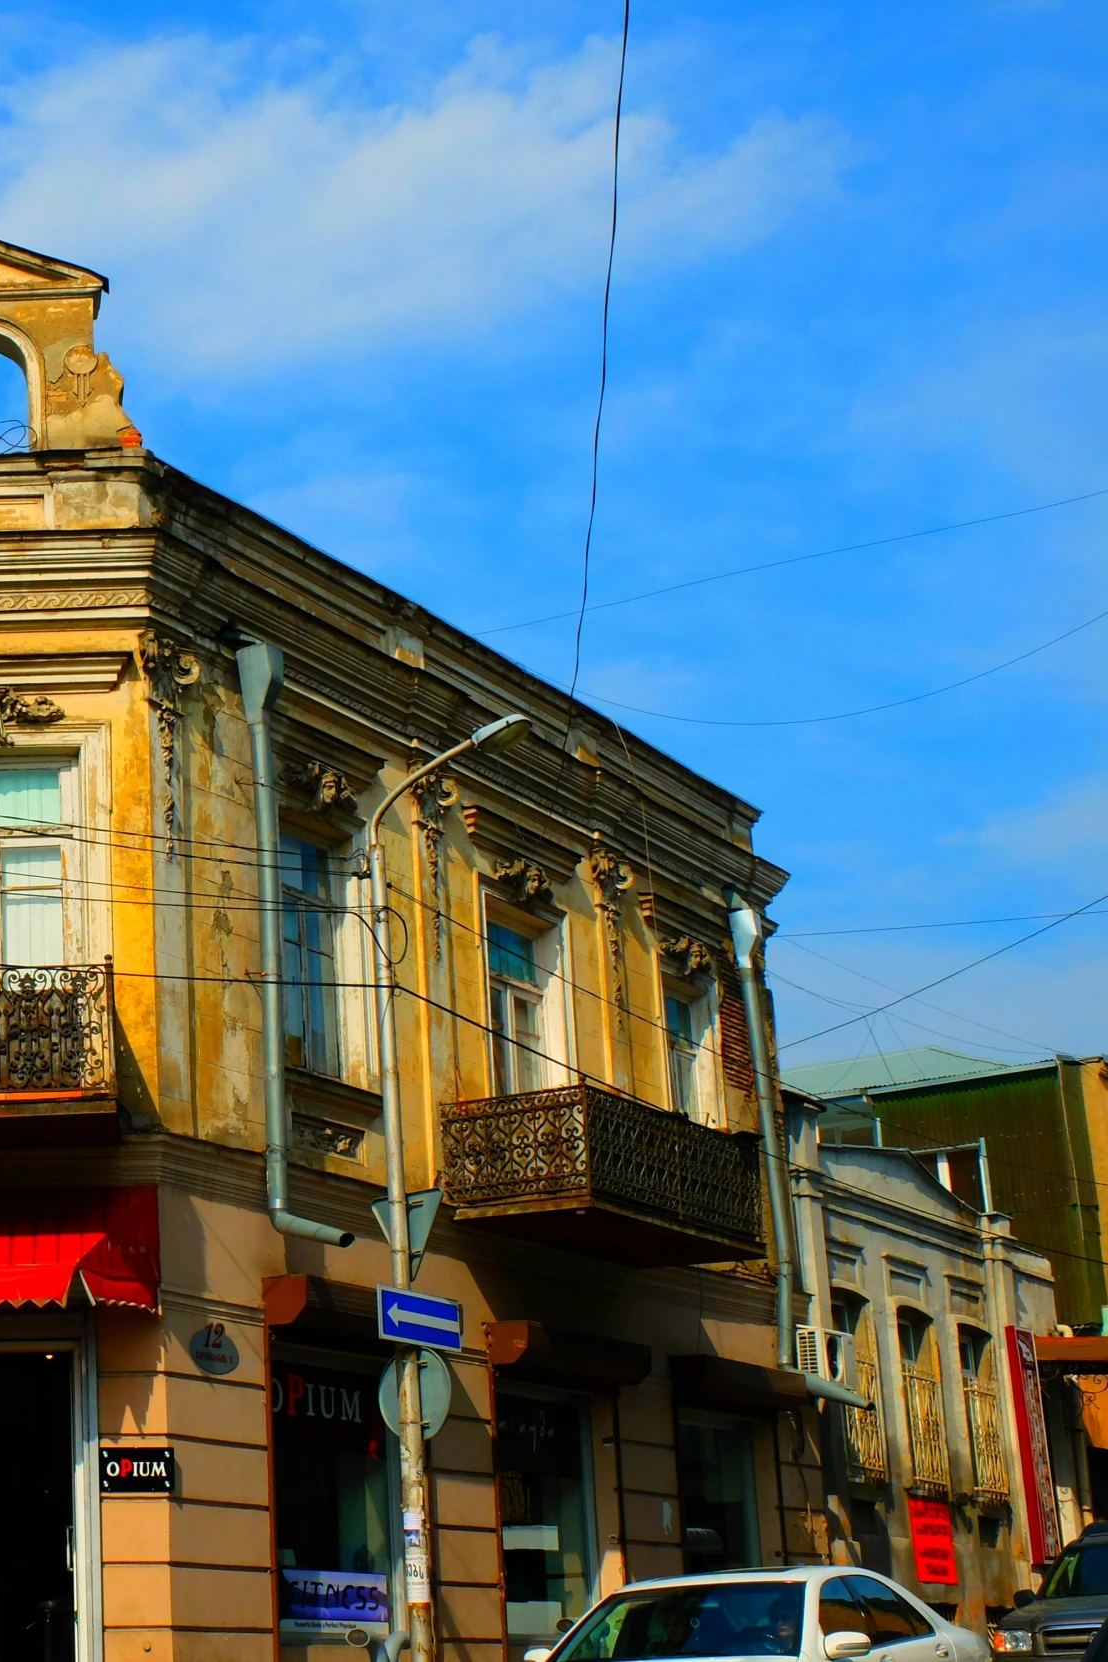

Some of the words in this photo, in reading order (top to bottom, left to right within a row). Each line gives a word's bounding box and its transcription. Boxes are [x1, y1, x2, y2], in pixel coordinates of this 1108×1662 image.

[204, 1321, 226, 1349] 12
[272, 1374, 362, 1423] OPIUM
[106, 1458, 167, 1477] OPIUM
